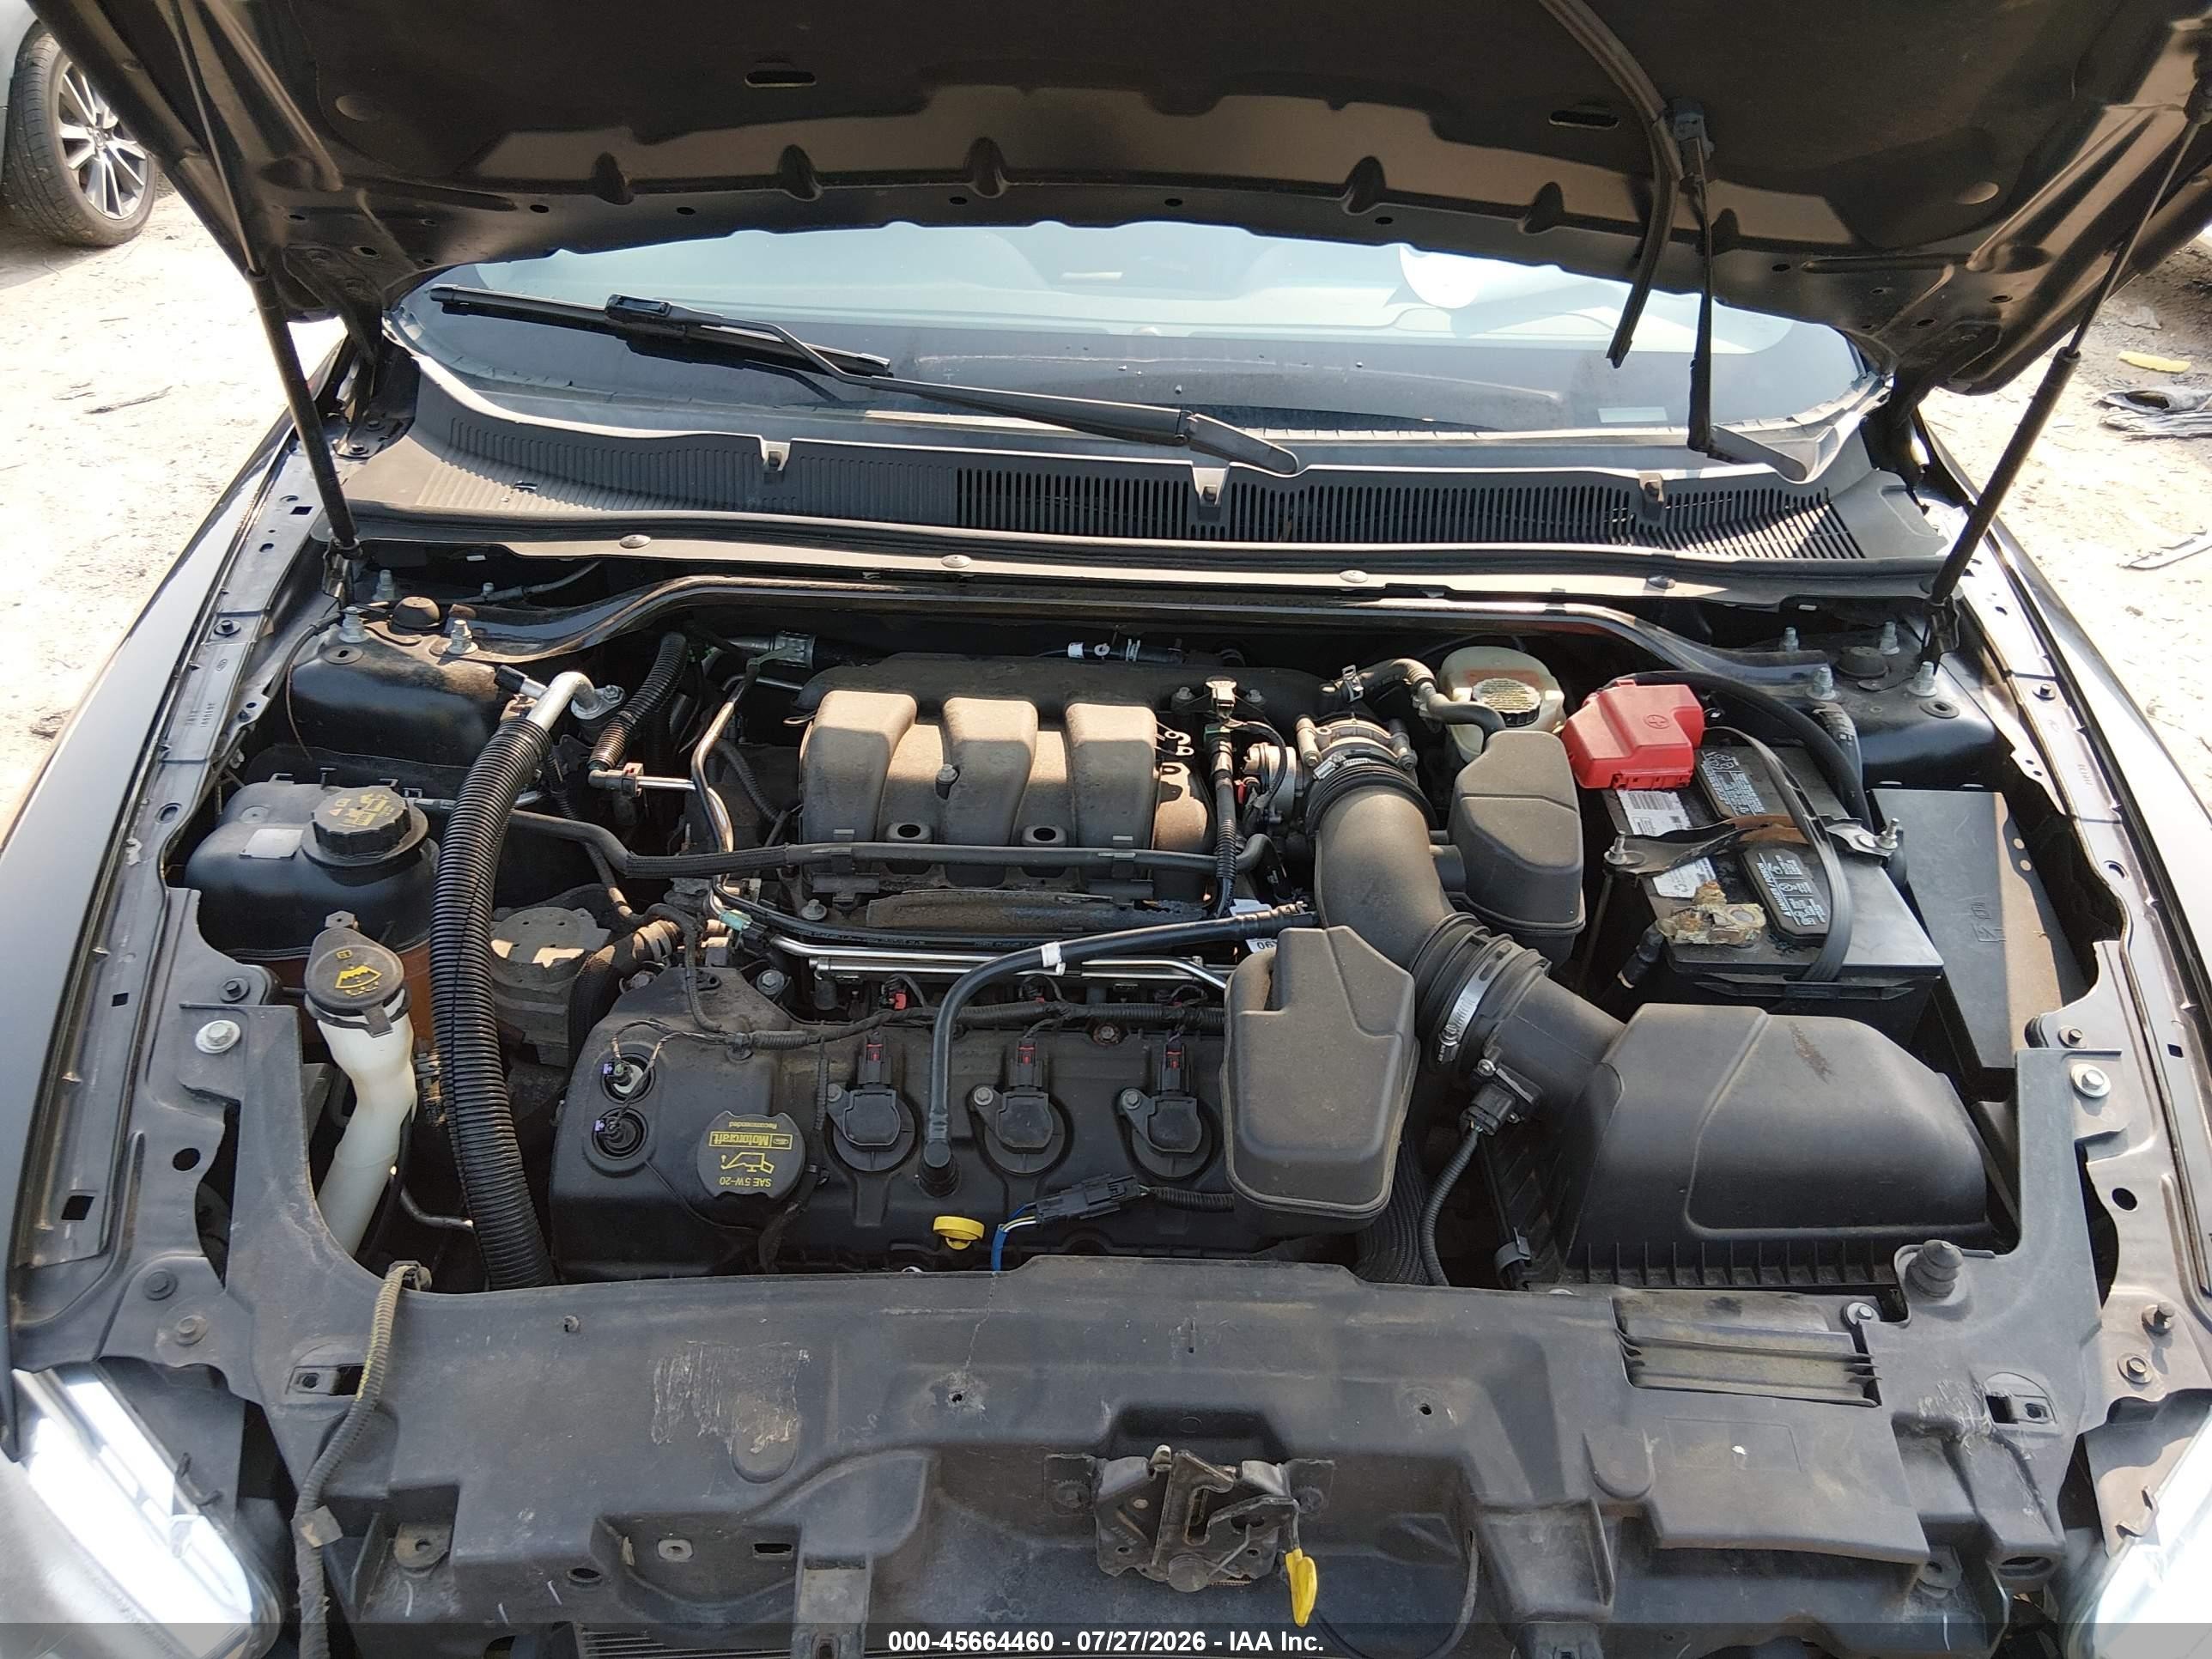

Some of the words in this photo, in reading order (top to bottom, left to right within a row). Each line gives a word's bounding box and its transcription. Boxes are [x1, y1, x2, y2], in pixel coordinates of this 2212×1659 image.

[714, 1133, 769, 1146] Motorcraft
[720, 1176, 751, 1186] 5W-20
[753, 1177, 772, 1187] SAE
